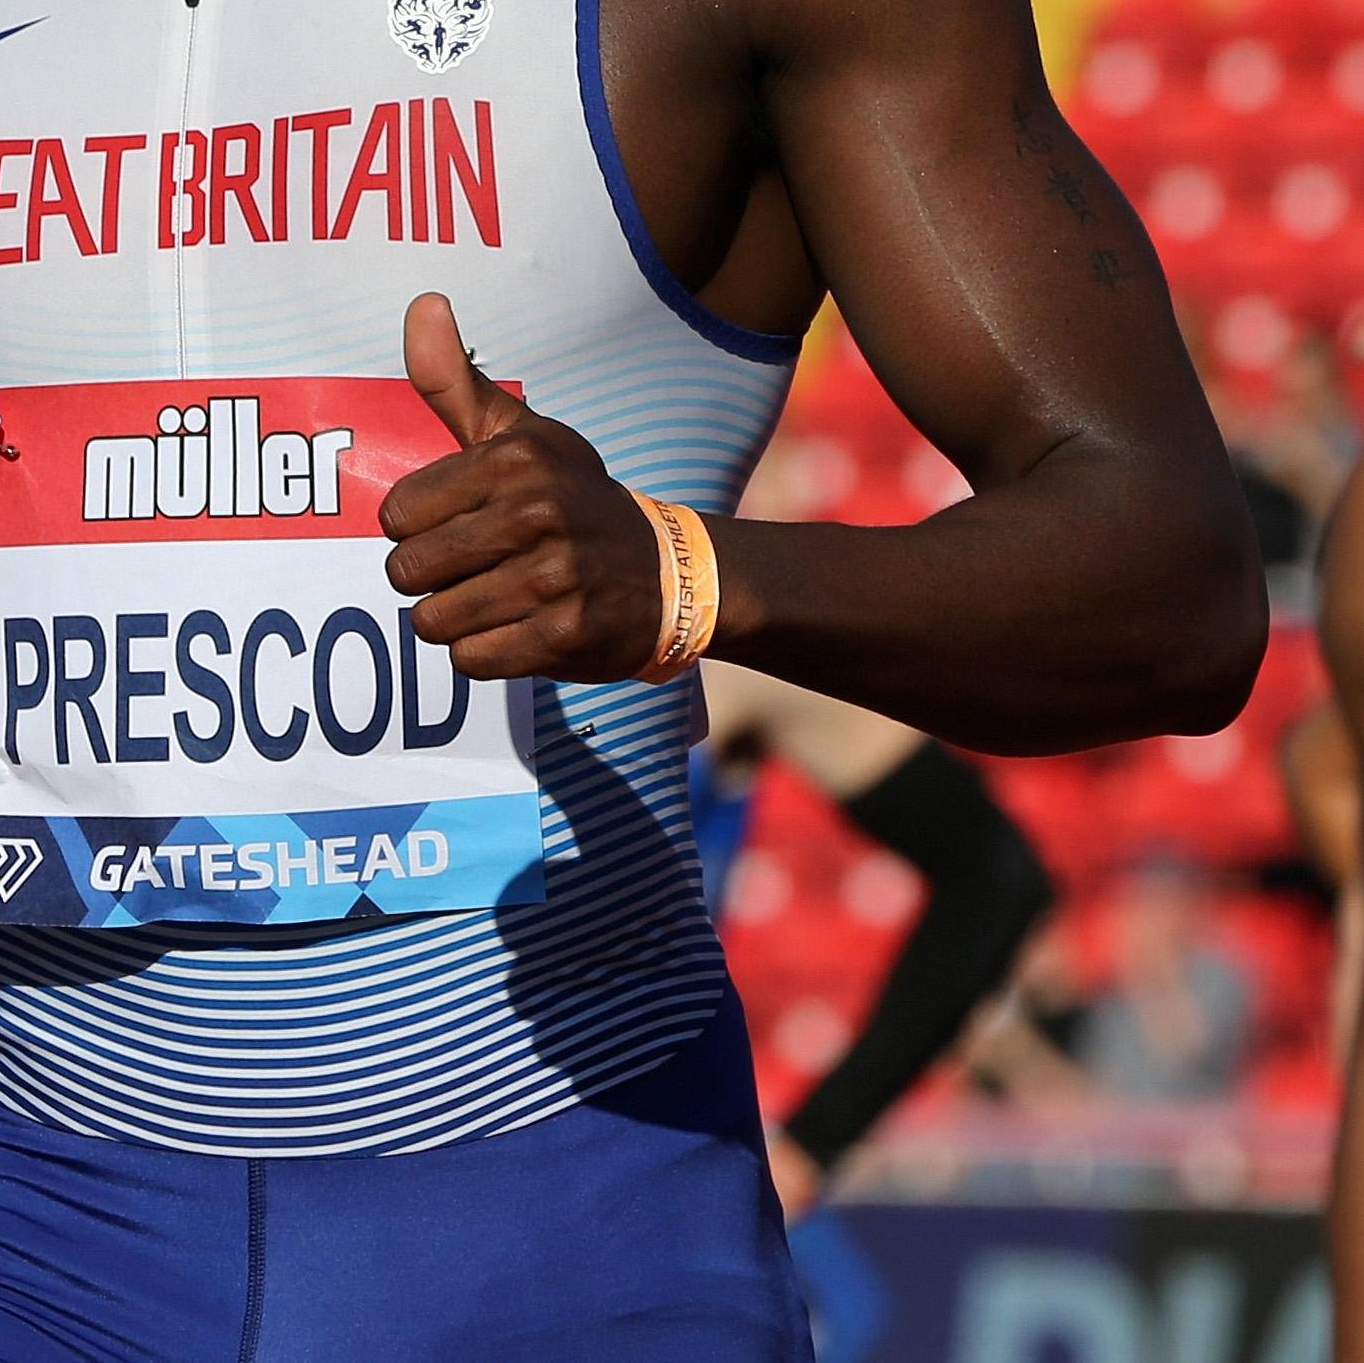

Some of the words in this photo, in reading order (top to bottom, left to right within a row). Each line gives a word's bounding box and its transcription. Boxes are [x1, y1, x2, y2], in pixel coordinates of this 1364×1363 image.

[158, 97, 502, 249] BRITAIN
[81, 396, 354, 523] müller
[88, 828, 450, 894] GATESHEAD
